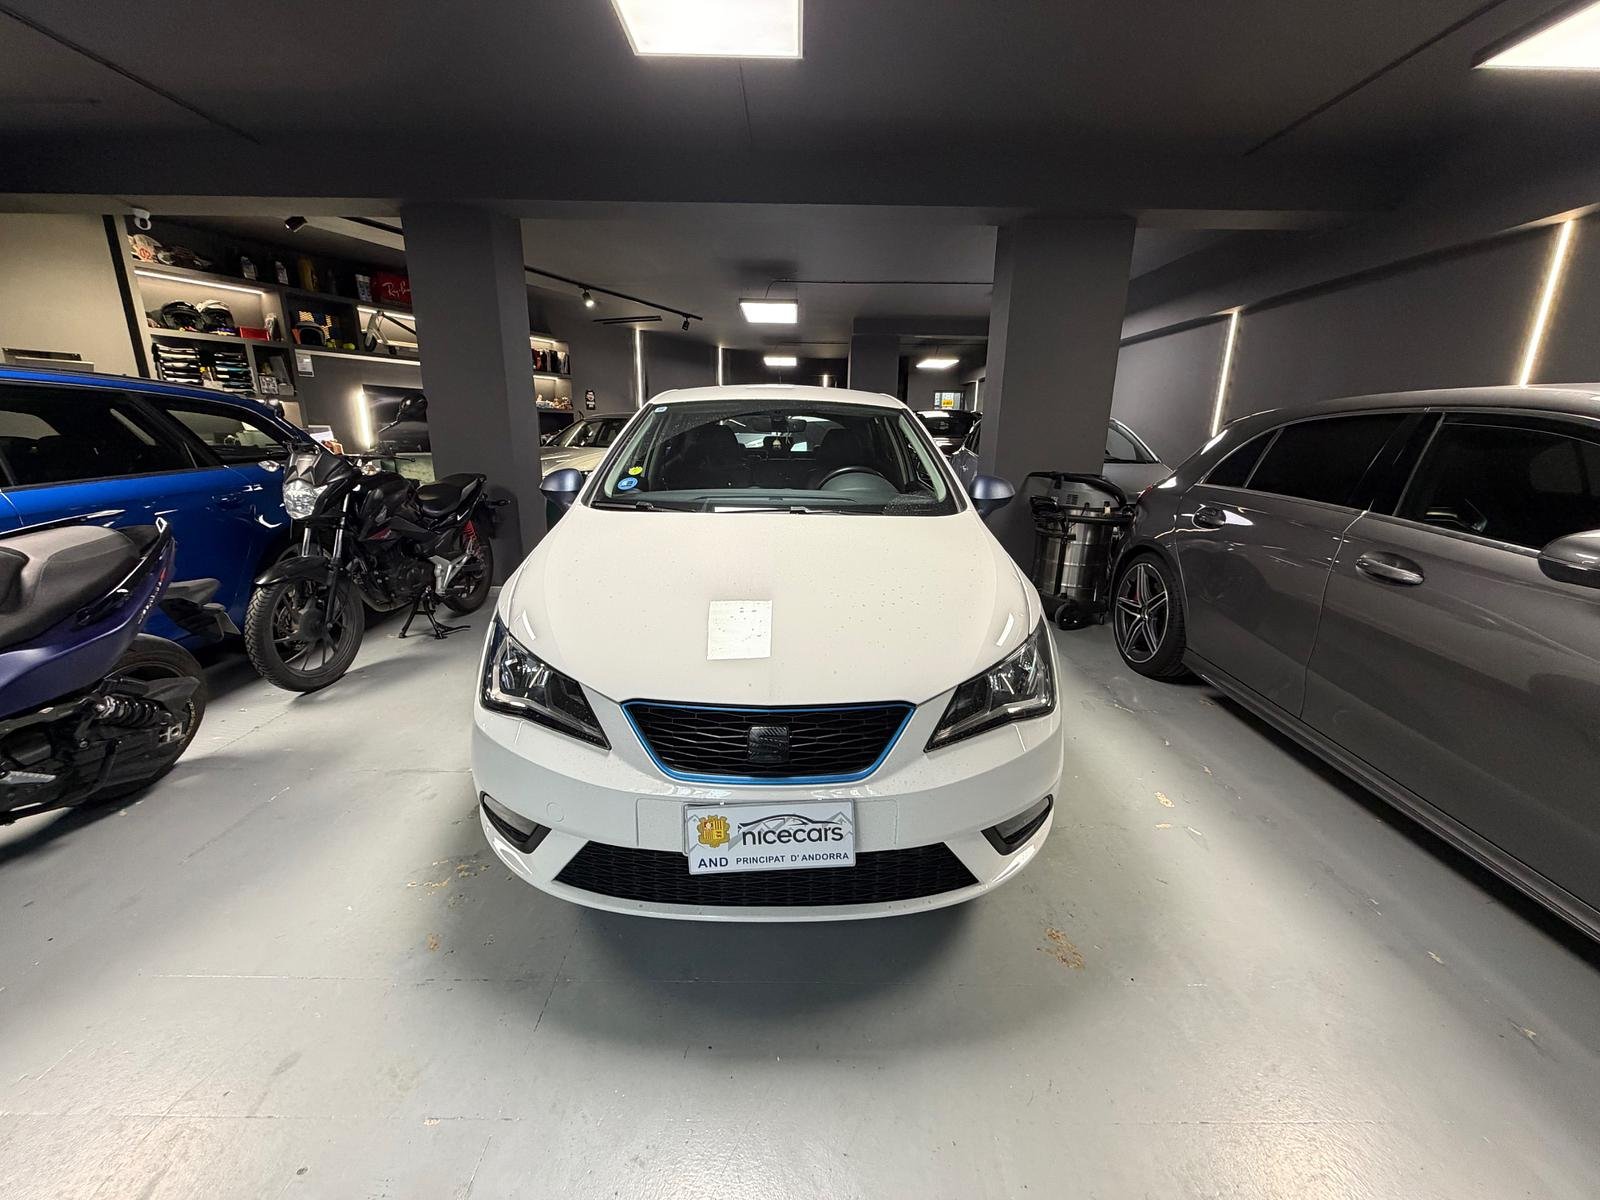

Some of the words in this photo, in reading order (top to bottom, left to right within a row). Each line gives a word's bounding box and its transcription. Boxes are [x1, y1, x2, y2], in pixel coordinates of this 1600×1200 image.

[742, 826, 844, 845] nicecars
[698, 857, 729, 869] AND
[736, 855, 786, 865] PRINCIPAT
